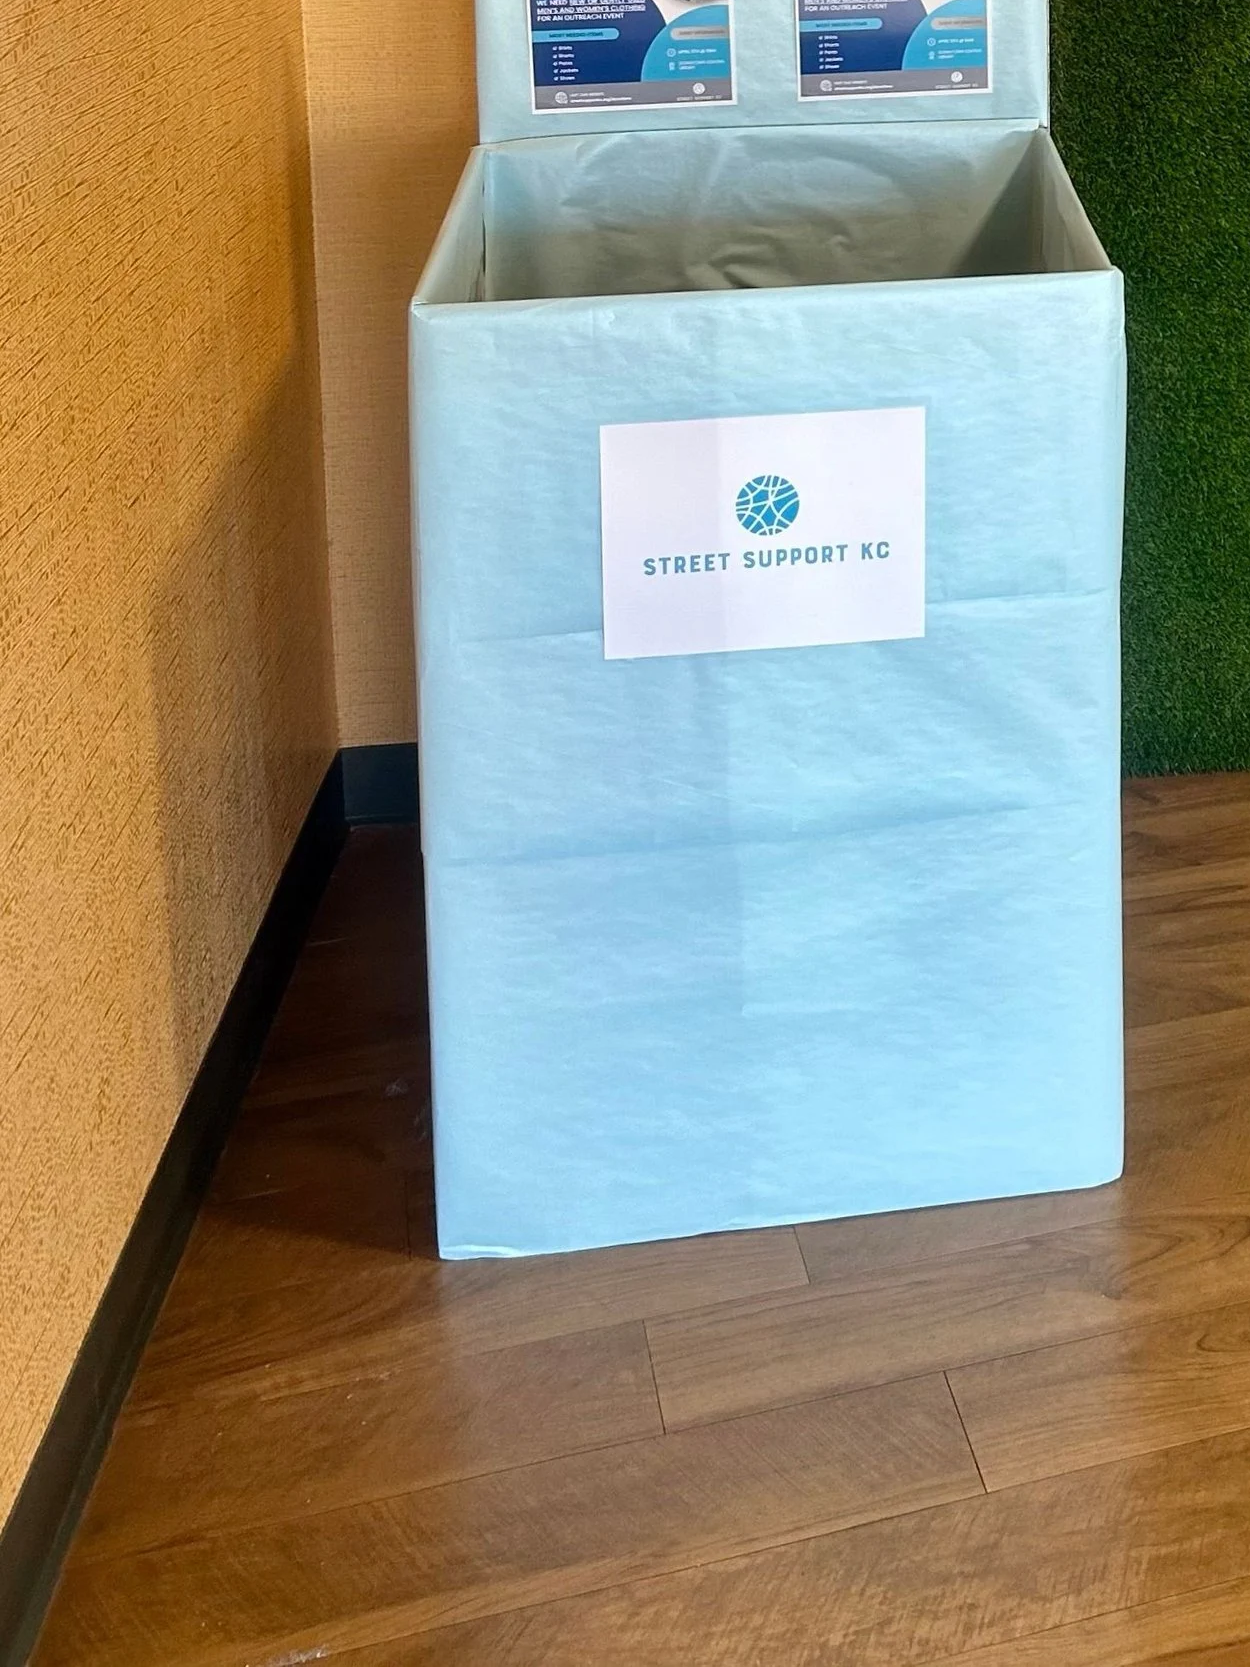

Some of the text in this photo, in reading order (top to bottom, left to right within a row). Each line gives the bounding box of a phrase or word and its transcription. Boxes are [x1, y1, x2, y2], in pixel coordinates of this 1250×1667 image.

[610, 4, 646, 12] CLOTHING
[564, 13, 602, 21] OUTREACH
[603, 12, 625, 20] EVENT
[643, 541, 891, 576] STREET SUPPORT KC
